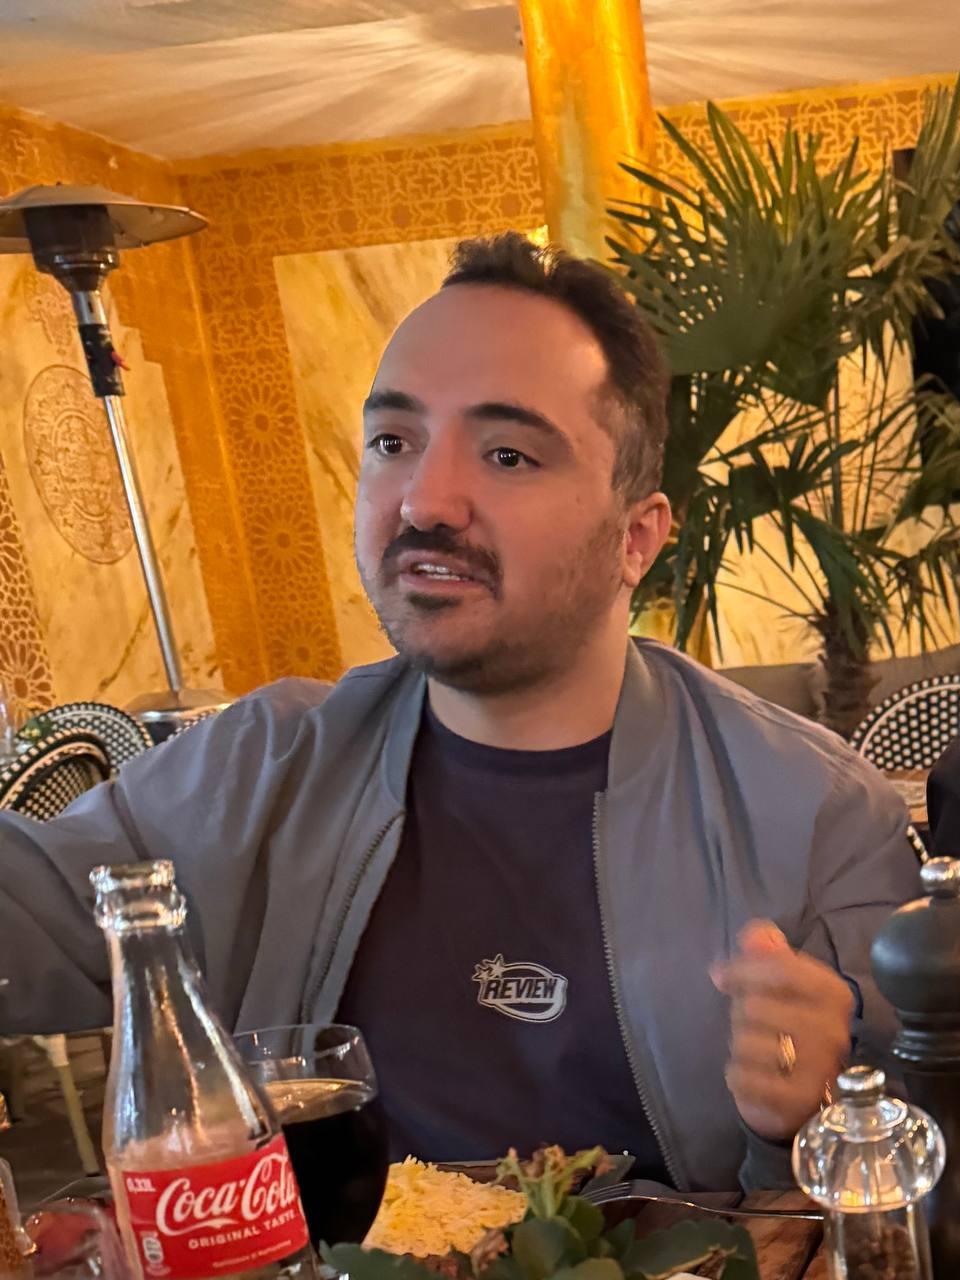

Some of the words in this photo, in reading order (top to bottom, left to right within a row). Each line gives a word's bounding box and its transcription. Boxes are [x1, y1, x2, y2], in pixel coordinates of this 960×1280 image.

[481, 978, 557, 1000] REVIEW
[156, 1152, 297, 1237] Coca-Cola
[187, 1226, 260, 1250] ORIGINAL
